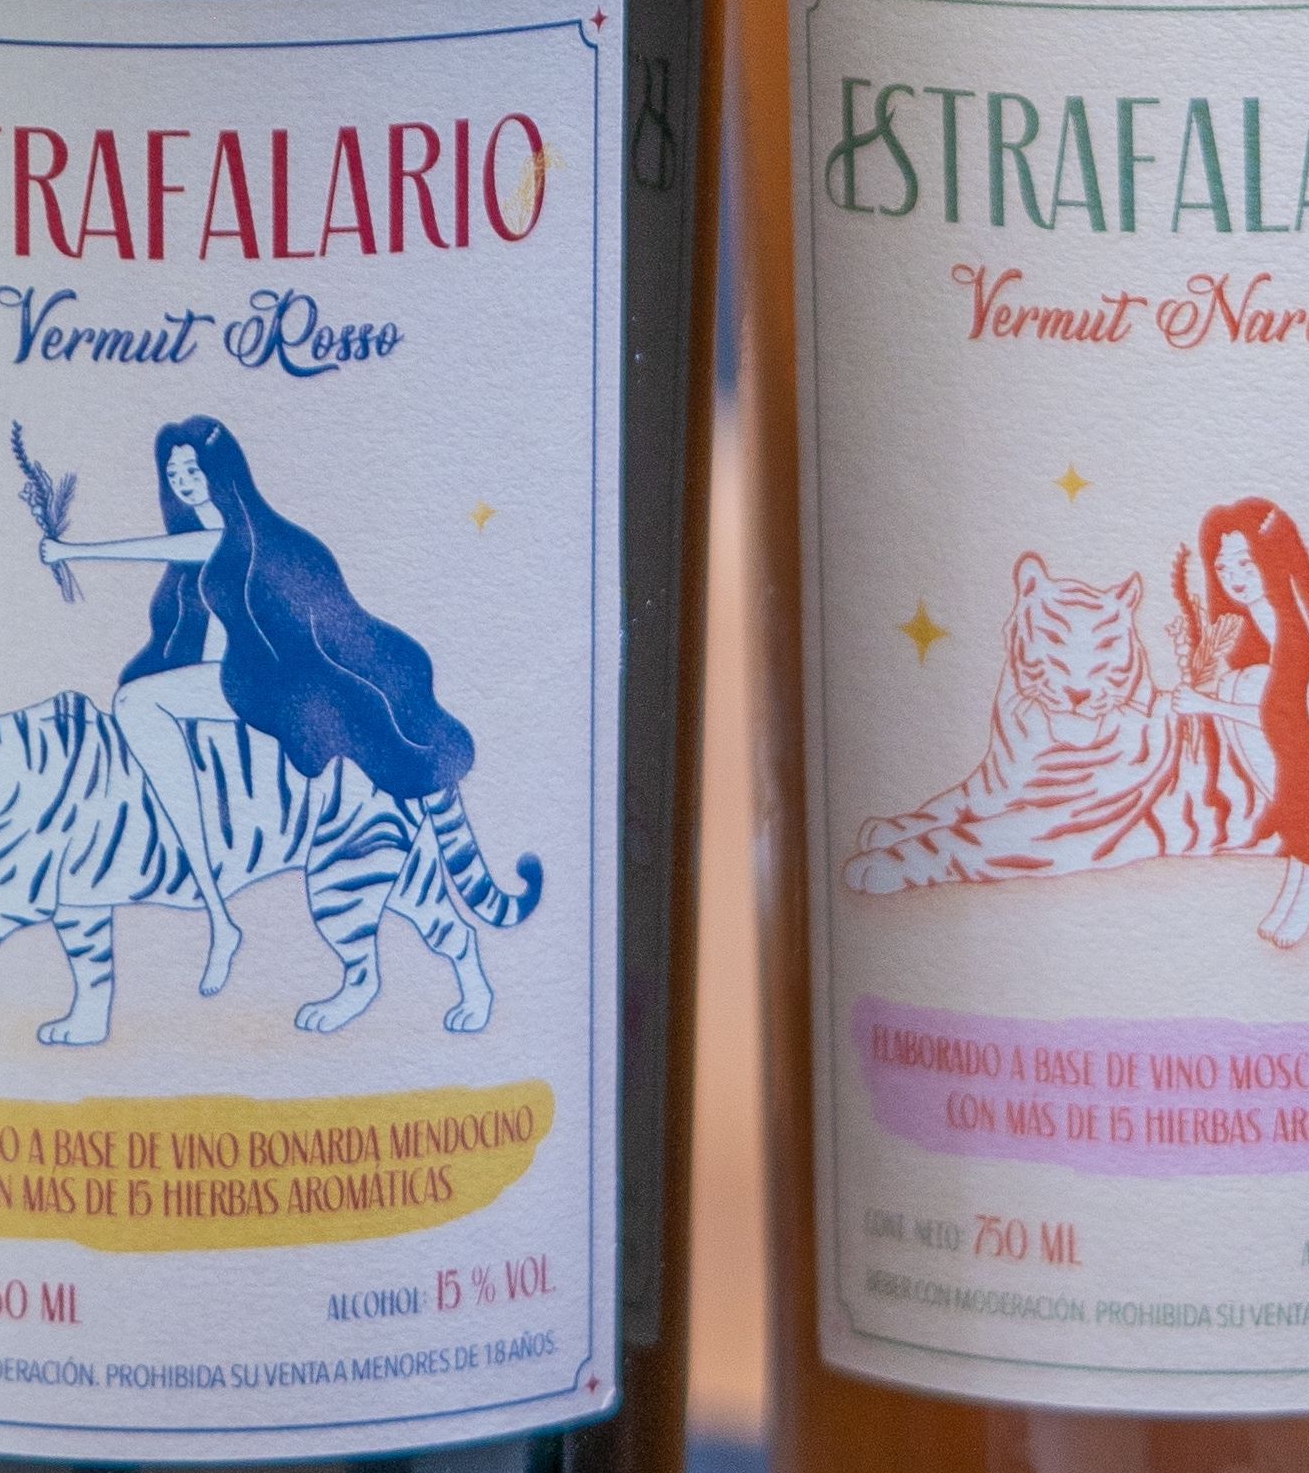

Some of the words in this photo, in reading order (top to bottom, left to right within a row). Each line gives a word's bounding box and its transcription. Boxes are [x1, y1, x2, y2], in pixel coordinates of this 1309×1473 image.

[951, 263, 1147, 343] Vermut
[224, 287, 404, 379] Rosso
[871, 1023, 1002, 1079] ELABORADO
[1012, 1044, 1026, 1082] A
[1034, 1047, 1095, 1087] BASE
[1106, 1051, 1138, 1089] DE
[1150, 1053, 1219, 1092] VINO
[29, 1127, 46, 1166] A
[54, 1129, 117, 1169] BASE
[128, 1131, 161, 1170] DE
[171, 1131, 239, 1170] VINO
[248, 1125, 380, 1169] BONARDA
[390, 1104, 534, 1160] MENDOCINO
[946, 1091, 996, 1132] CON
[1067, 1104, 1099, 1142] DE
[1108, 1105, 1135, 1144] 15
[1145, 1107, 1263, 1145] HIERBAS
[85, 1178, 118, 1217] DE
[128, 1179, 153, 1217] 15
[163, 1178, 278, 1217] HIERBAS
[973, 1213, 1030, 1261] 750
[1041, 1221, 1083, 1267] ML
[42, 1281, 82, 1326] ML
[436, 1269, 462, 1310] 15
[471, 1266, 495, 1305] %
[1095, 1300, 1211, 1327] PROHIBIDA
[1217, 1304, 1244, 1329] SU
[106, 1362, 226, 1389] PROHIBIDA
[231, 1363, 258, 1389] SU
[263, 1359, 330, 1387] VENTA
[333, 1358, 348, 1383] A
[352, 1348, 450, 1381] MENORES
[455, 1343, 479, 1371] DE
[485, 1339, 506, 1366] 18
